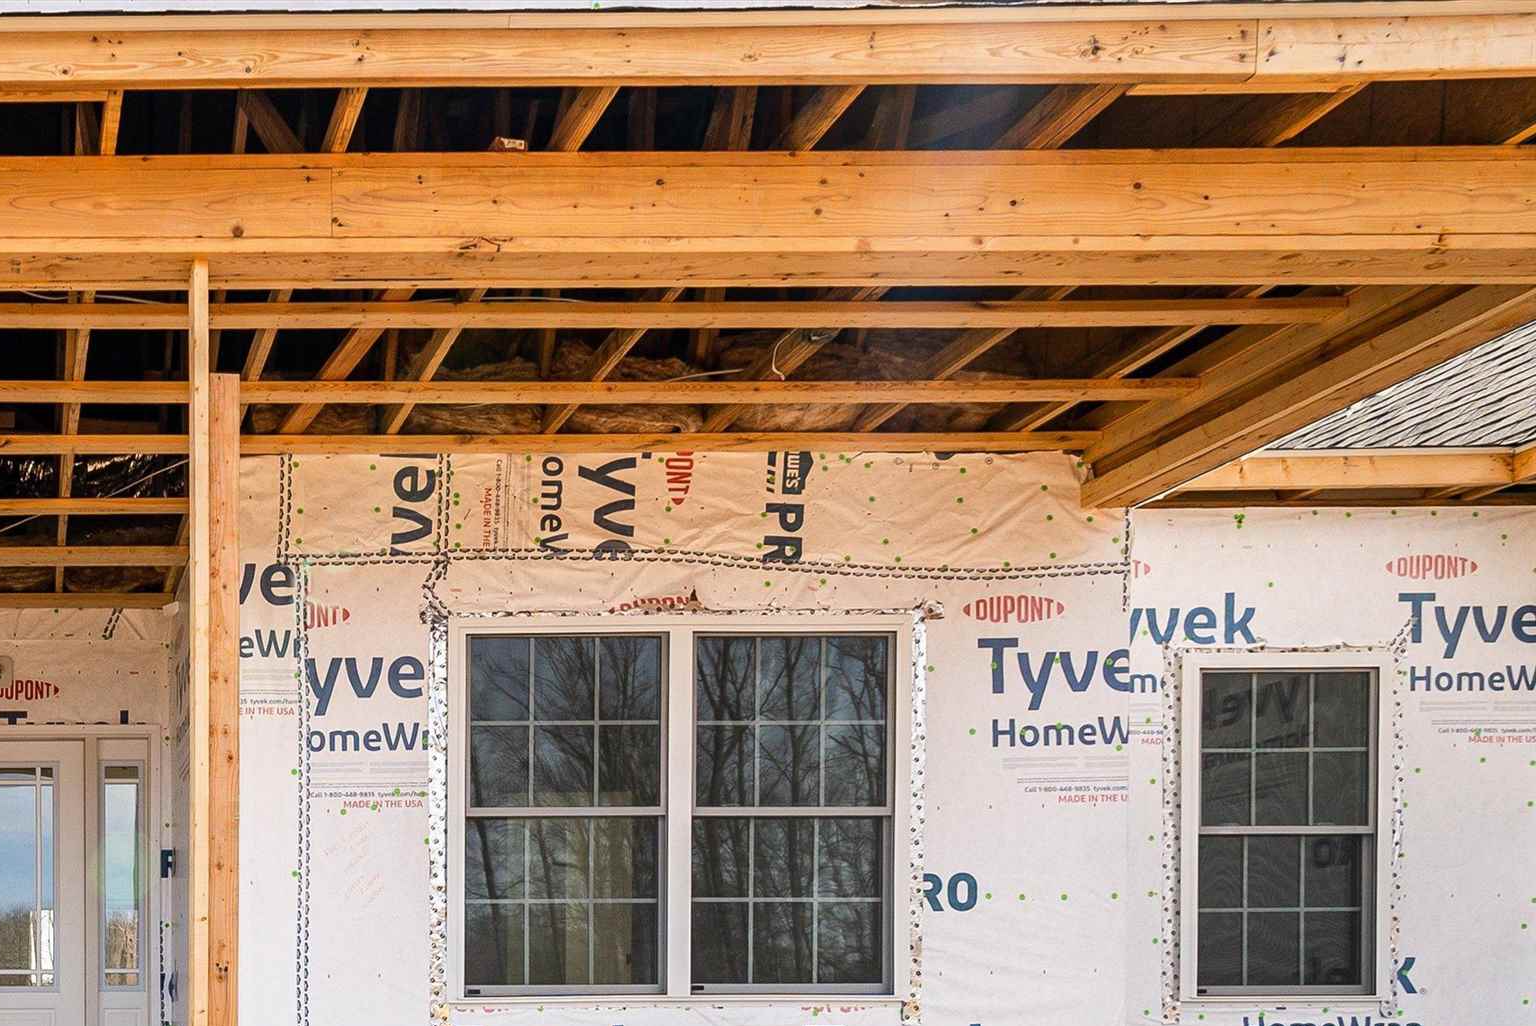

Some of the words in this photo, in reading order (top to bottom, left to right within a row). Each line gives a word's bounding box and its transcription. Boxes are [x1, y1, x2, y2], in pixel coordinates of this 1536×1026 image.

[665, 452, 694, 497] ONT
[1398, 554, 1468, 580] DUPONT
[975, 596, 1054, 623] DUPONT
